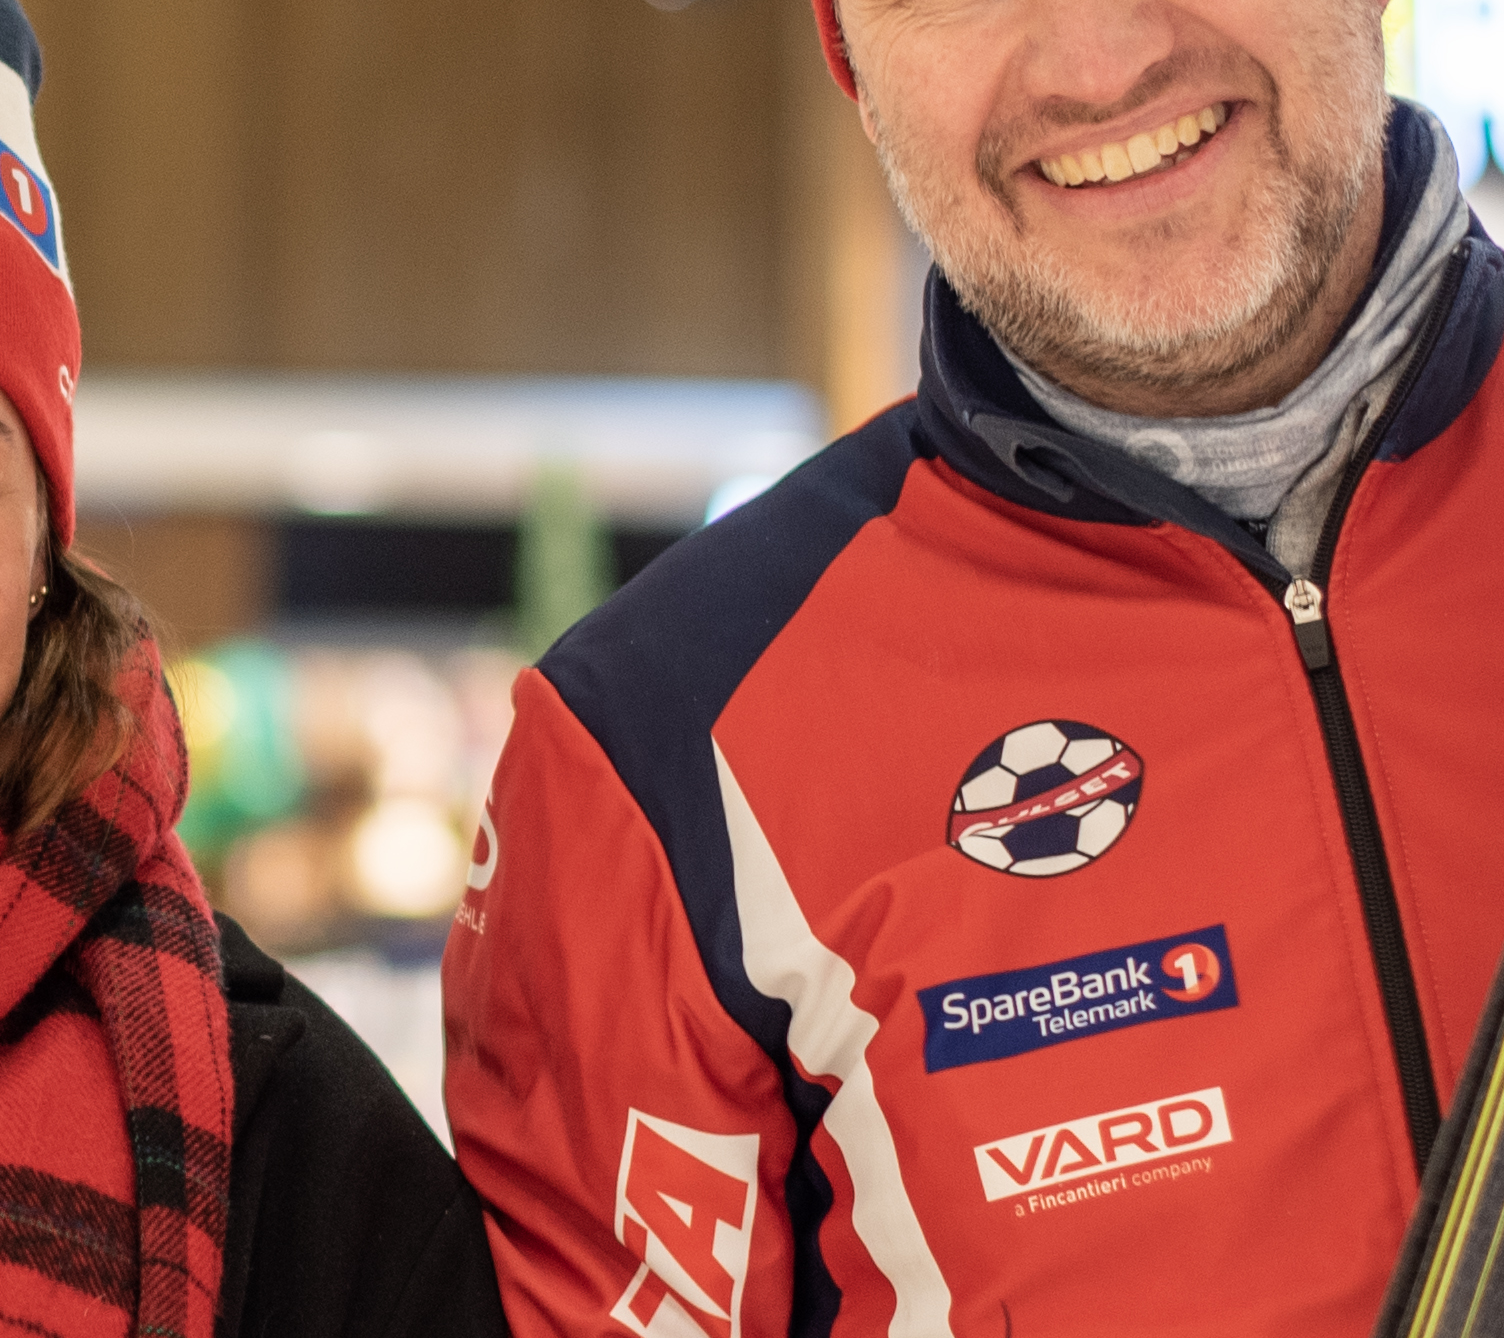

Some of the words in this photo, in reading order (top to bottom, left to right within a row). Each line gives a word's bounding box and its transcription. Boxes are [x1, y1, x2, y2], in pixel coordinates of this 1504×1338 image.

[941, 956, 1152, 1035] SpareBank
[1032, 989, 1158, 1037] Telemark
[984, 1098, 1214, 1188] VARD
[1014, 1202, 1026, 1217] a
[1027, 1173, 1129, 1214] Fincantieri
[1130, 1154, 1213, 1188] company
